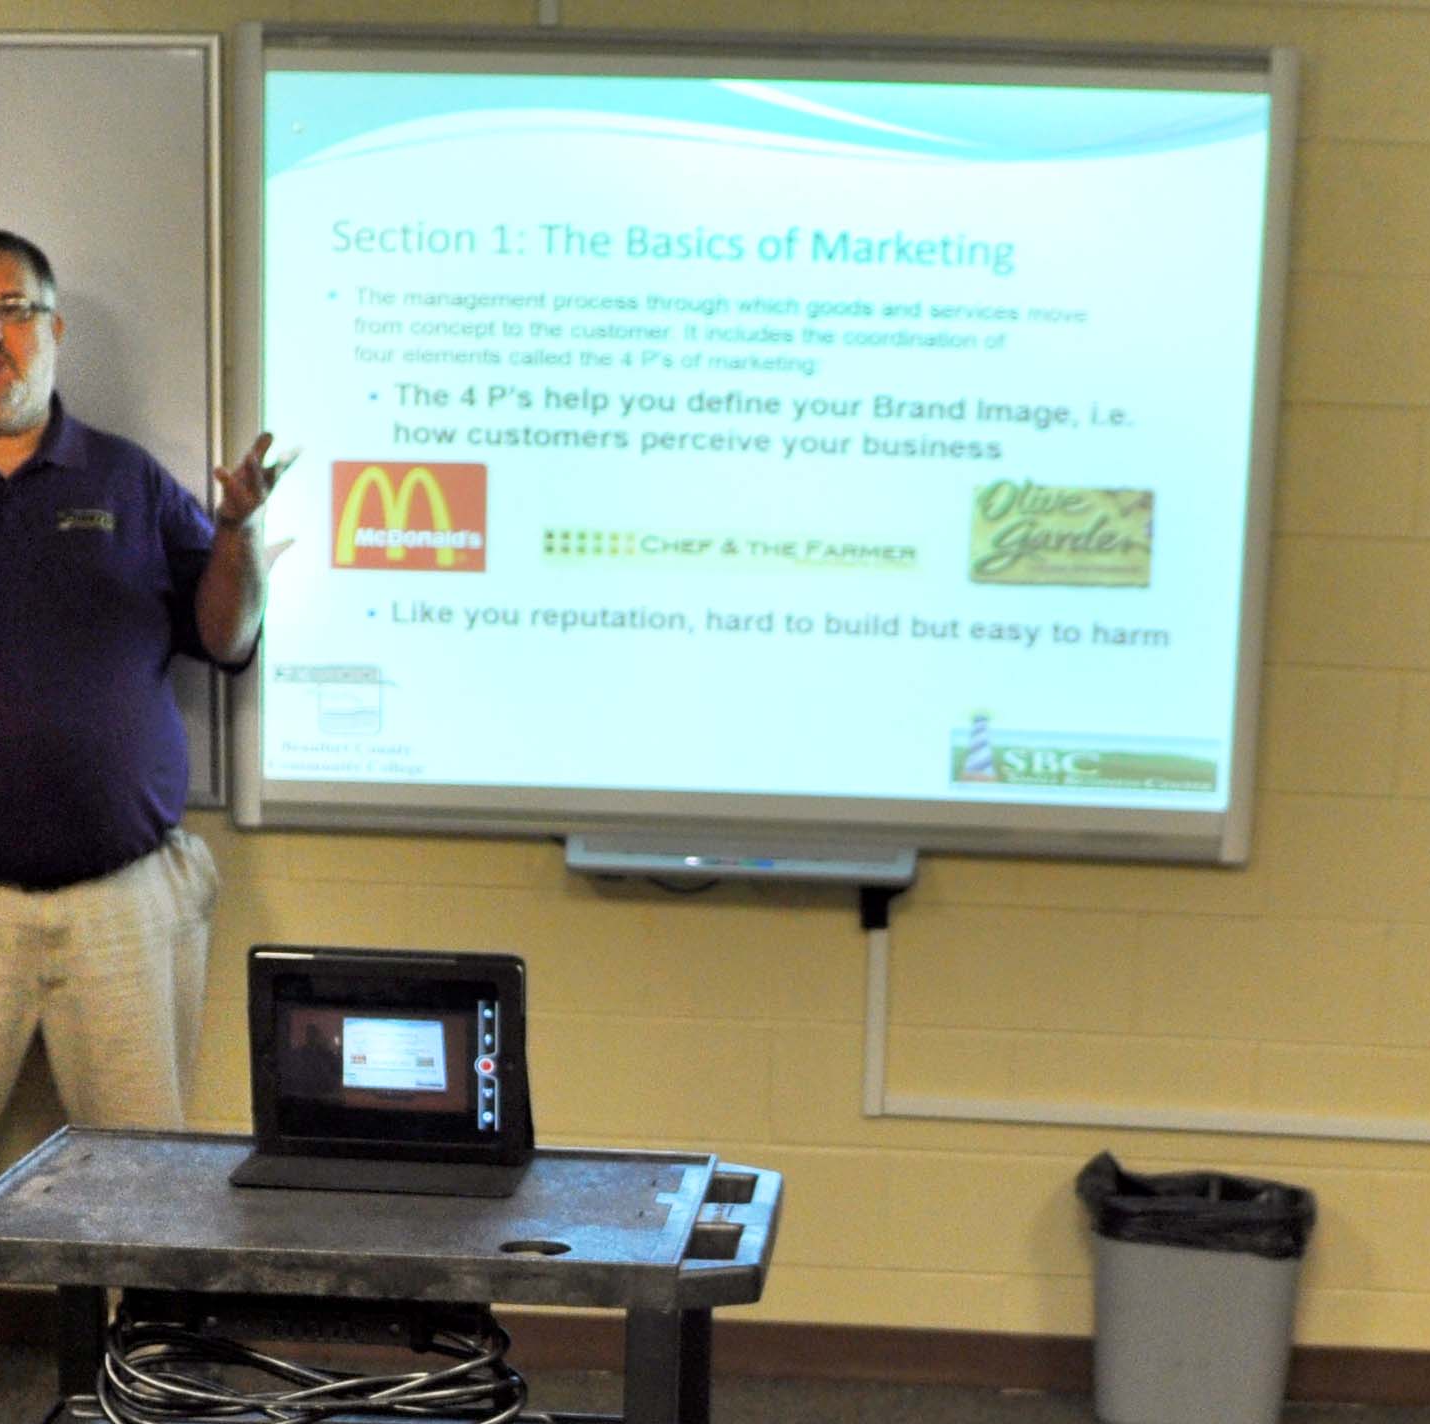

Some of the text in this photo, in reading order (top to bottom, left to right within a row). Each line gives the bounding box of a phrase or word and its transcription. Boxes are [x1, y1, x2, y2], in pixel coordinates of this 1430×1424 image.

[331, 220, 1017, 277] Section 1: The Basics of Marketing
[356, 286, 1088, 323] The management process through which goods and services move
[355, 316, 402, 335] from
[410, 319, 495, 339] concept
[502, 320, 525, 338] to
[530, 320, 564, 339] the
[683, 322, 699, 341] It
[705, 324, 794, 343] includes
[802, 326, 835, 345] the
[843, 328, 977, 349] coordination
[983, 332, 1008, 350] of
[355, 345, 394, 364] four
[402, 346, 502, 367] elements
[509, 348, 572, 368] called
[580, 349, 612, 368] the
[619, 350, 634, 368] 4
[641, 350, 674, 369] P's
[681, 350, 701, 369] of
[395, 384, 1135, 430] The 4 P's help you define your Brand Image, i.e.
[393, 421, 1004, 461] how customers perceive your business
[974, 478, 1092, 521] Olive
[354, 527, 483, 550] McDonald's
[639, 534, 916, 561] CHEF & THE FARMER
[391, 601, 1170, 648] Like you reputation, hard to build but easy to harm
[1002, 749, 1101, 776] SBC
